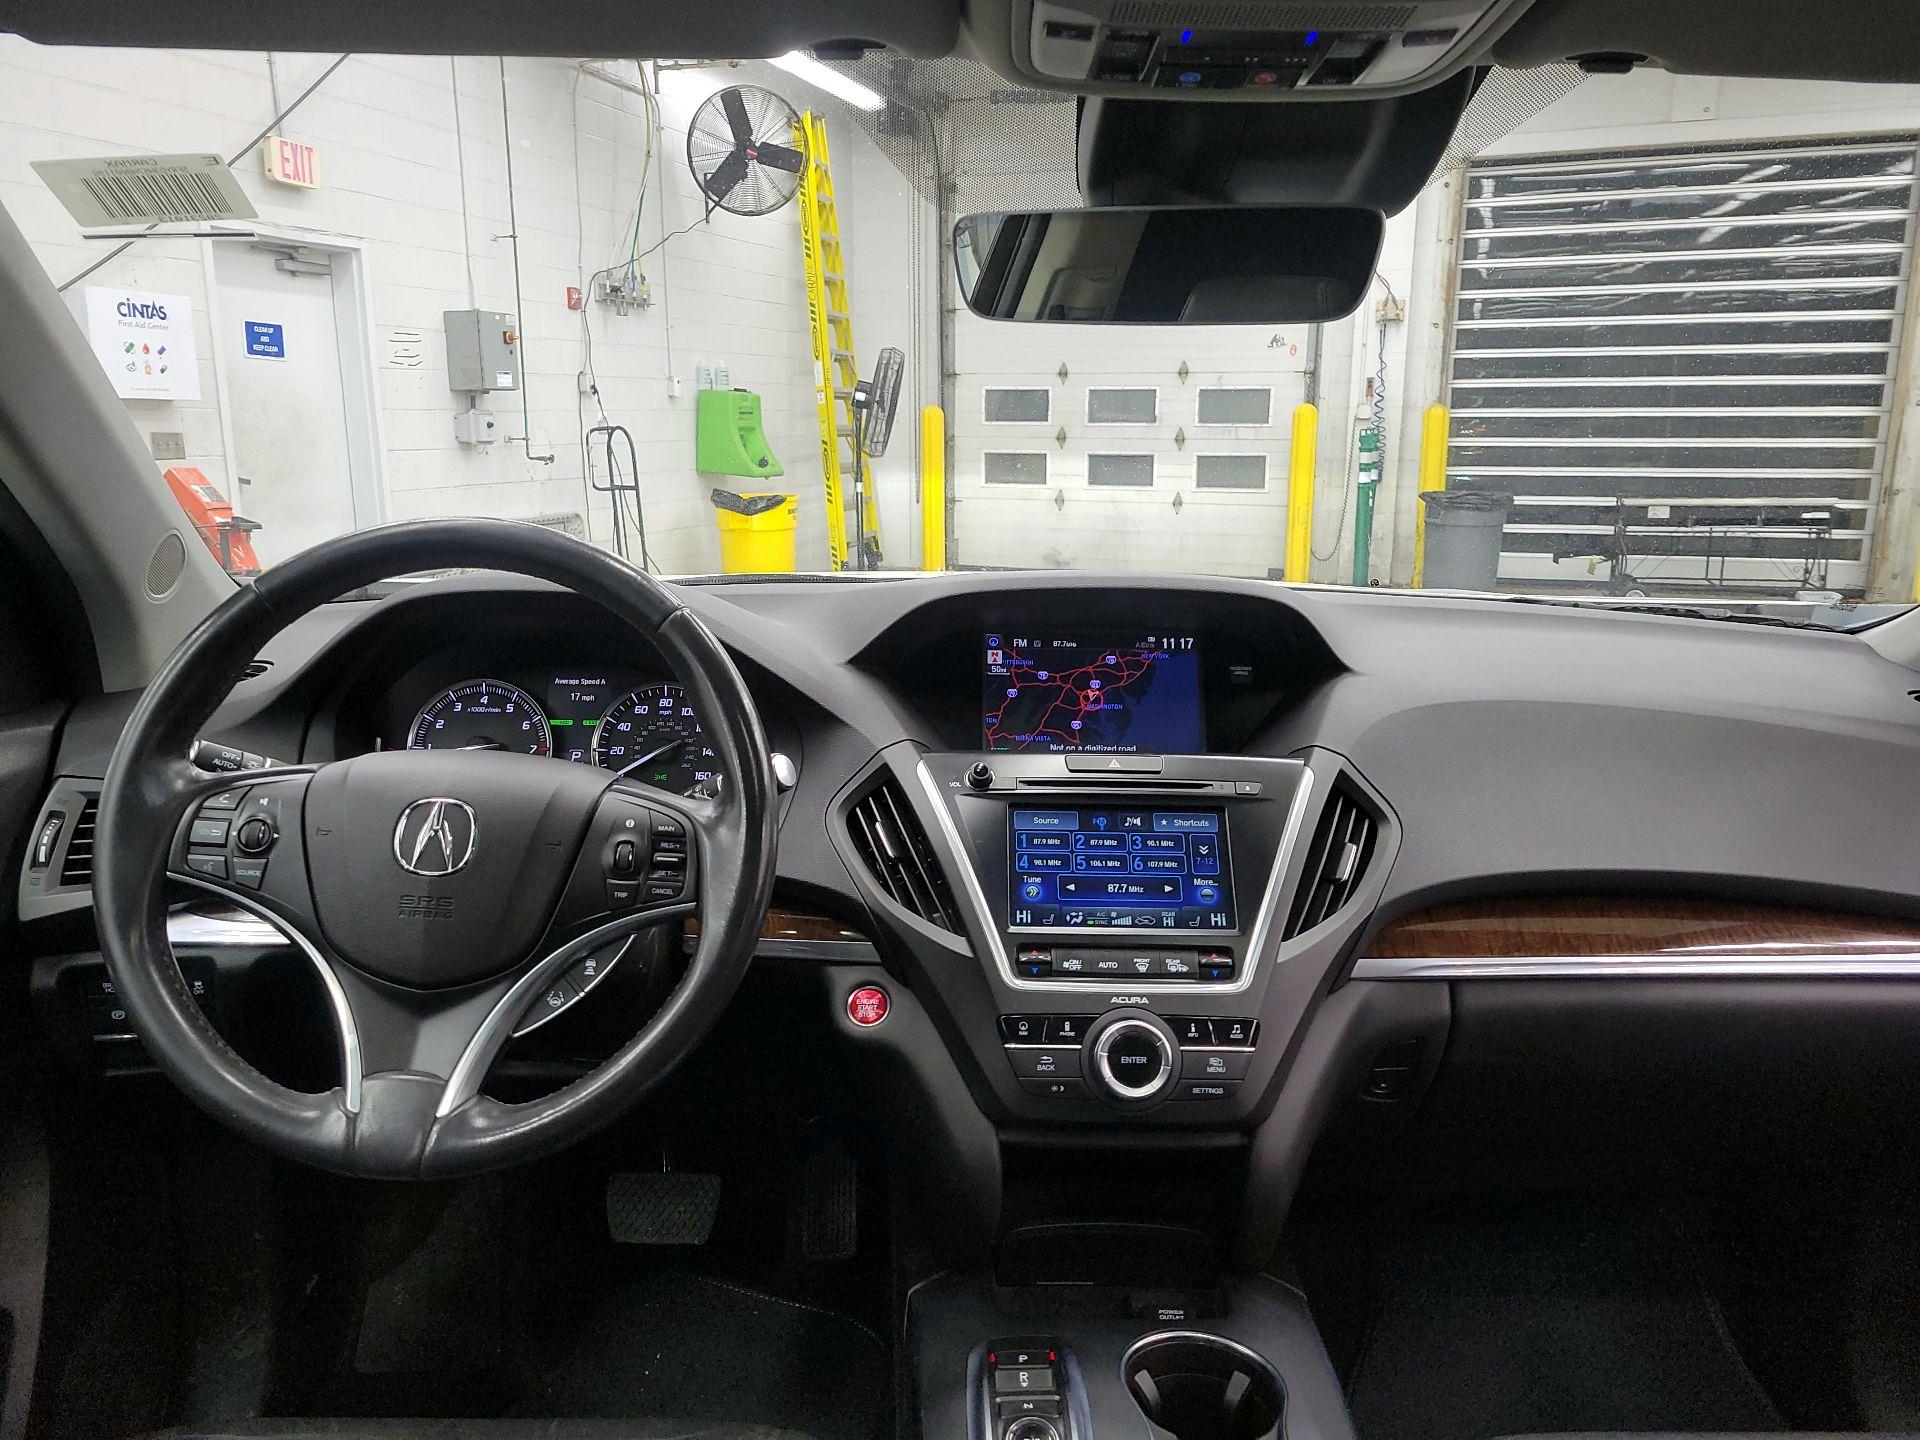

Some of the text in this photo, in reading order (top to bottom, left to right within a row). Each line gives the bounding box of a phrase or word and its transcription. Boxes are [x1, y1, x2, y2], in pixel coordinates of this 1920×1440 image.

[280, 140, 314, 185] EXIT
[117, 297, 168, 320] CINTAS
[118, 319, 169, 331] First Aid Center
[1013, 639, 1027, 648] FM
[554, 678, 580, 686] Average
[580, 678, 600, 686] Speed
[480, 695, 488, 705] 4
[570, 692, 580, 701] 17
[453, 702, 462, 712] 3
[659, 698, 673, 707] 80
[505, 703, 514, 713] 5
[634, 705, 648, 714] 60
[435, 719, 445, 729] 2
[522, 721, 530, 730] 6
[617, 722, 631, 731] 40
[529, 744, 537, 754] 7
[610, 746, 624, 755] 20
[702, 747, 715, 757] 14
[1050, 743, 1064, 751] Not
[1117, 744, 1136, 752] road
[221, 751, 237, 760] OFF
[571, 751, 582, 762] P
[212, 758, 234, 769] AUTO
[694, 771, 711, 781] 160
[1033, 816, 1059, 825] Source
[1173, 818, 1210, 827] Shortcuts
[1020, 833, 1027, 848] 1
[1075, 834, 1086, 849] 2
[1132, 835, 1142, 850] 3
[1019, 854, 1029, 869] 4
[1076, 855, 1087, 870] 5
[1133, 856, 1144, 871] 6
[1196, 857, 1214, 865] 7-12
[1022, 875, 1042, 883] Tune
[651, 887, 674, 895] CANCEL
[1107, 883, 1144, 893] 87.7 MHz
[1016, 909, 1031, 924] Hi
[1162, 916, 1175, 927] Hi
[1210, 912, 1227, 927] Hi
[1098, 961, 1118, 969] AUTO
[1110, 996, 1150, 1004] ACURA
[1120, 1056, 1148, 1064] ENTER
[1018, 1354, 1028, 1363] P
[1019, 1371, 1029, 1383] R
